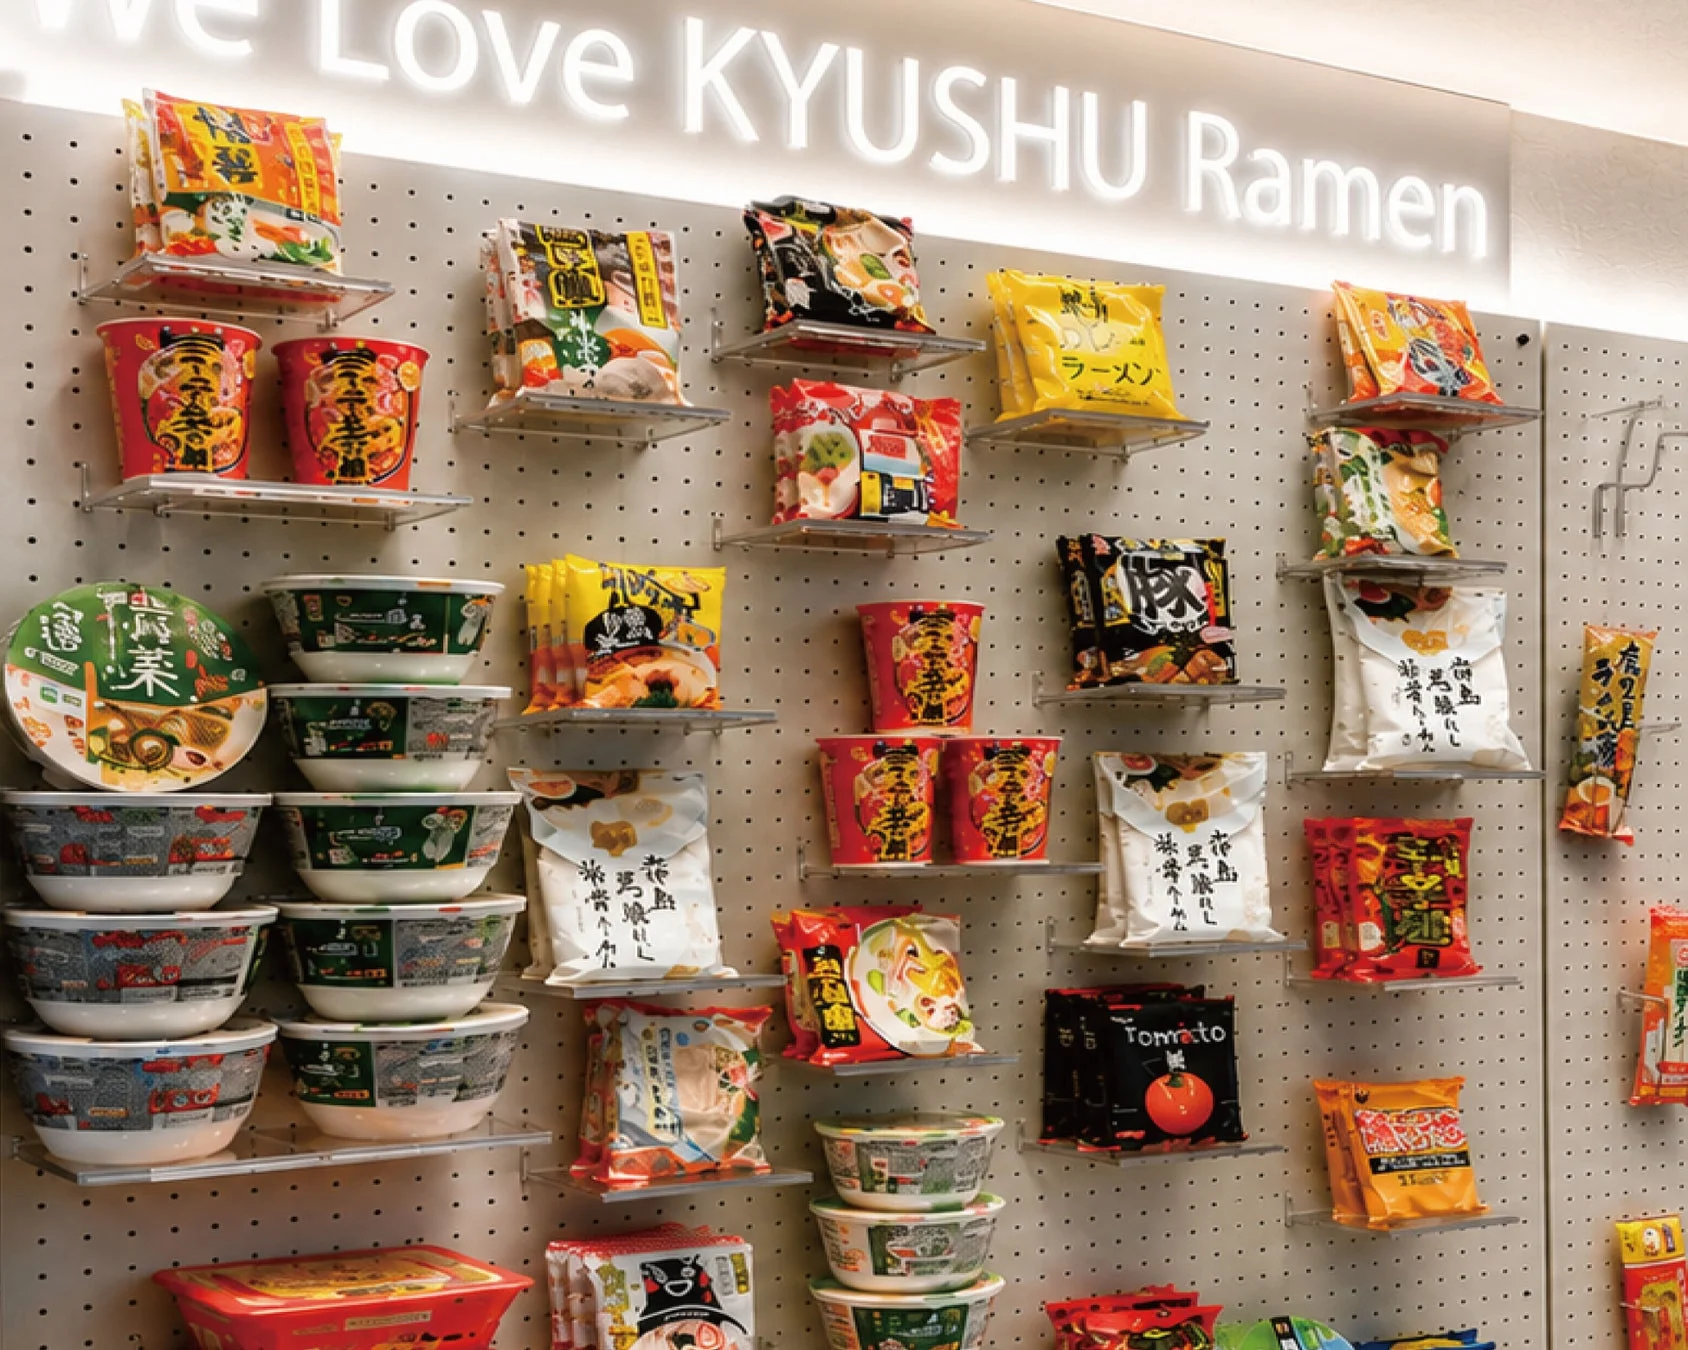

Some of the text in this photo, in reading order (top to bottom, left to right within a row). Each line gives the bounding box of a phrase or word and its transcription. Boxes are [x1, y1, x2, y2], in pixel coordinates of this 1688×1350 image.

[318, 0, 636, 120] Love
[682, 17, 1147, 200] KYUSHU
[1184, 108, 1489, 259] Ramen
[1061, 355, 1161, 386] ラーメン
[1124, 1020, 1227, 1048] Tomato
